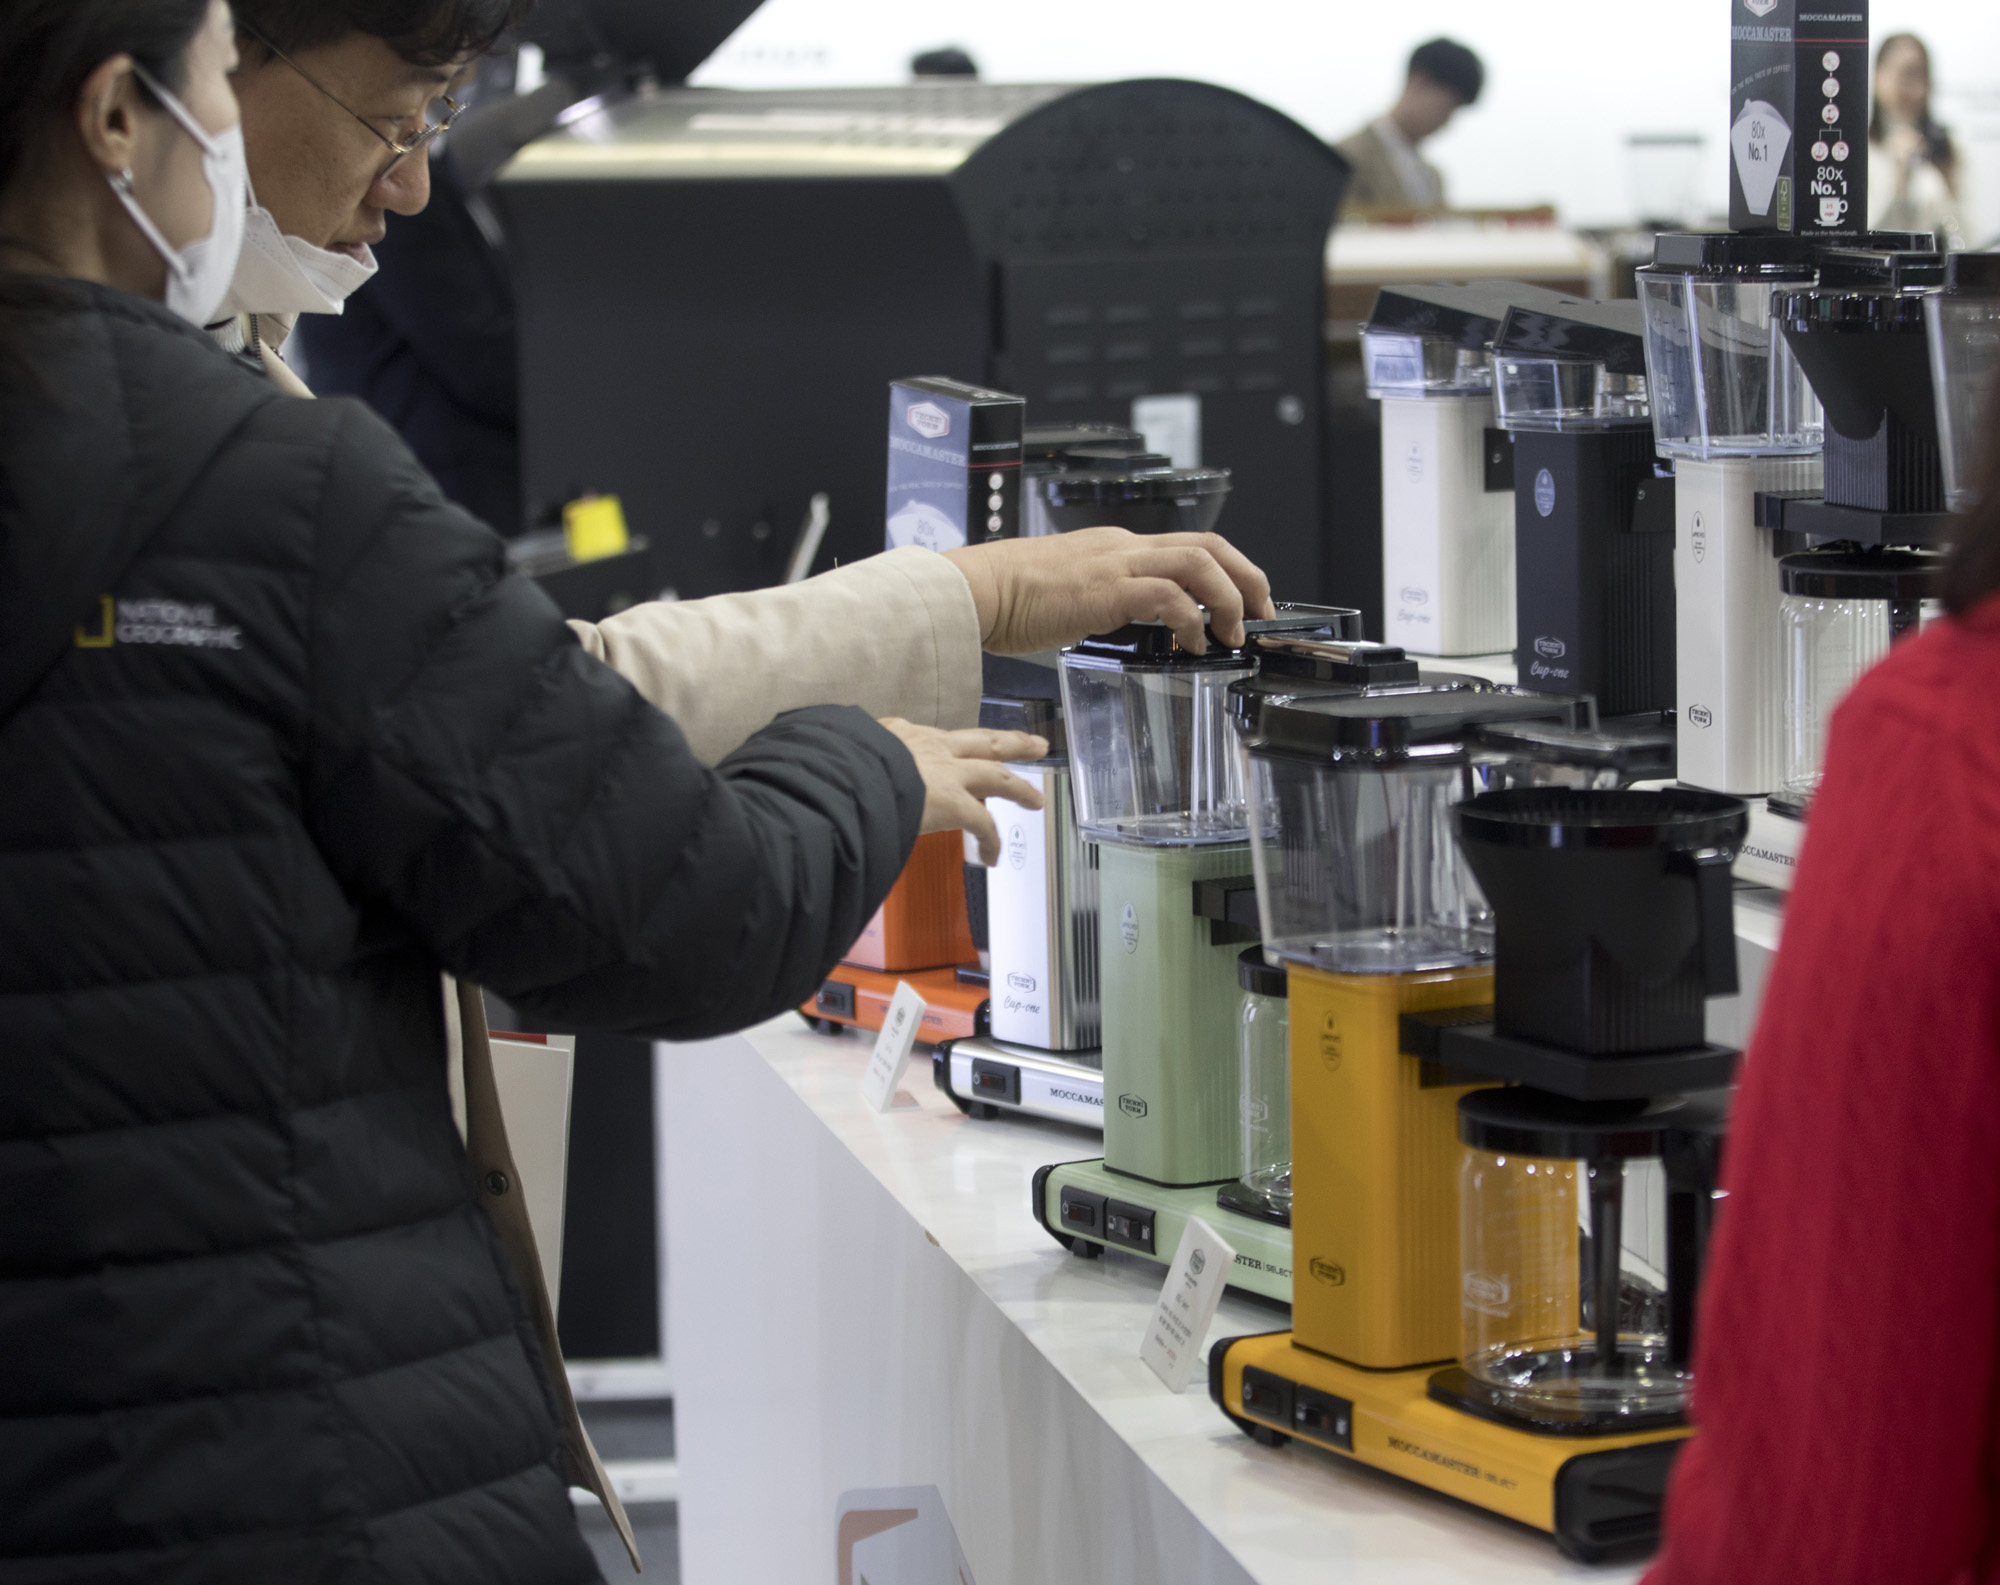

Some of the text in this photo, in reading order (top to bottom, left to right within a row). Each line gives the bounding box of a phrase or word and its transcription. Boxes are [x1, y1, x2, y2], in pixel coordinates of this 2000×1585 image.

[1799, 13, 1863, 22] MOCCAMASTER
[1731, 26, 1792, 42] MOCCAMASTER
[1752, 121, 1765, 139] 80x
[1749, 142, 1761, 161] No.
[1817, 166, 1843, 181] 80x
[1811, 181, 1847, 195] No. 1
[890, 435, 966, 469] MOCCAMASTER
[917, 519, 935, 538] 80x
[118, 600, 217, 626] NATIONAL
[116, 624, 243, 650] GEOGRAPHIC
[1531, 660, 1569, 679] Cup-one
[1741, 844, 1796, 867] OCCAMASTER
[1004, 995, 1040, 1014] Cup-one
[1050, 1087, 1104, 1107] MOCCAMAS
